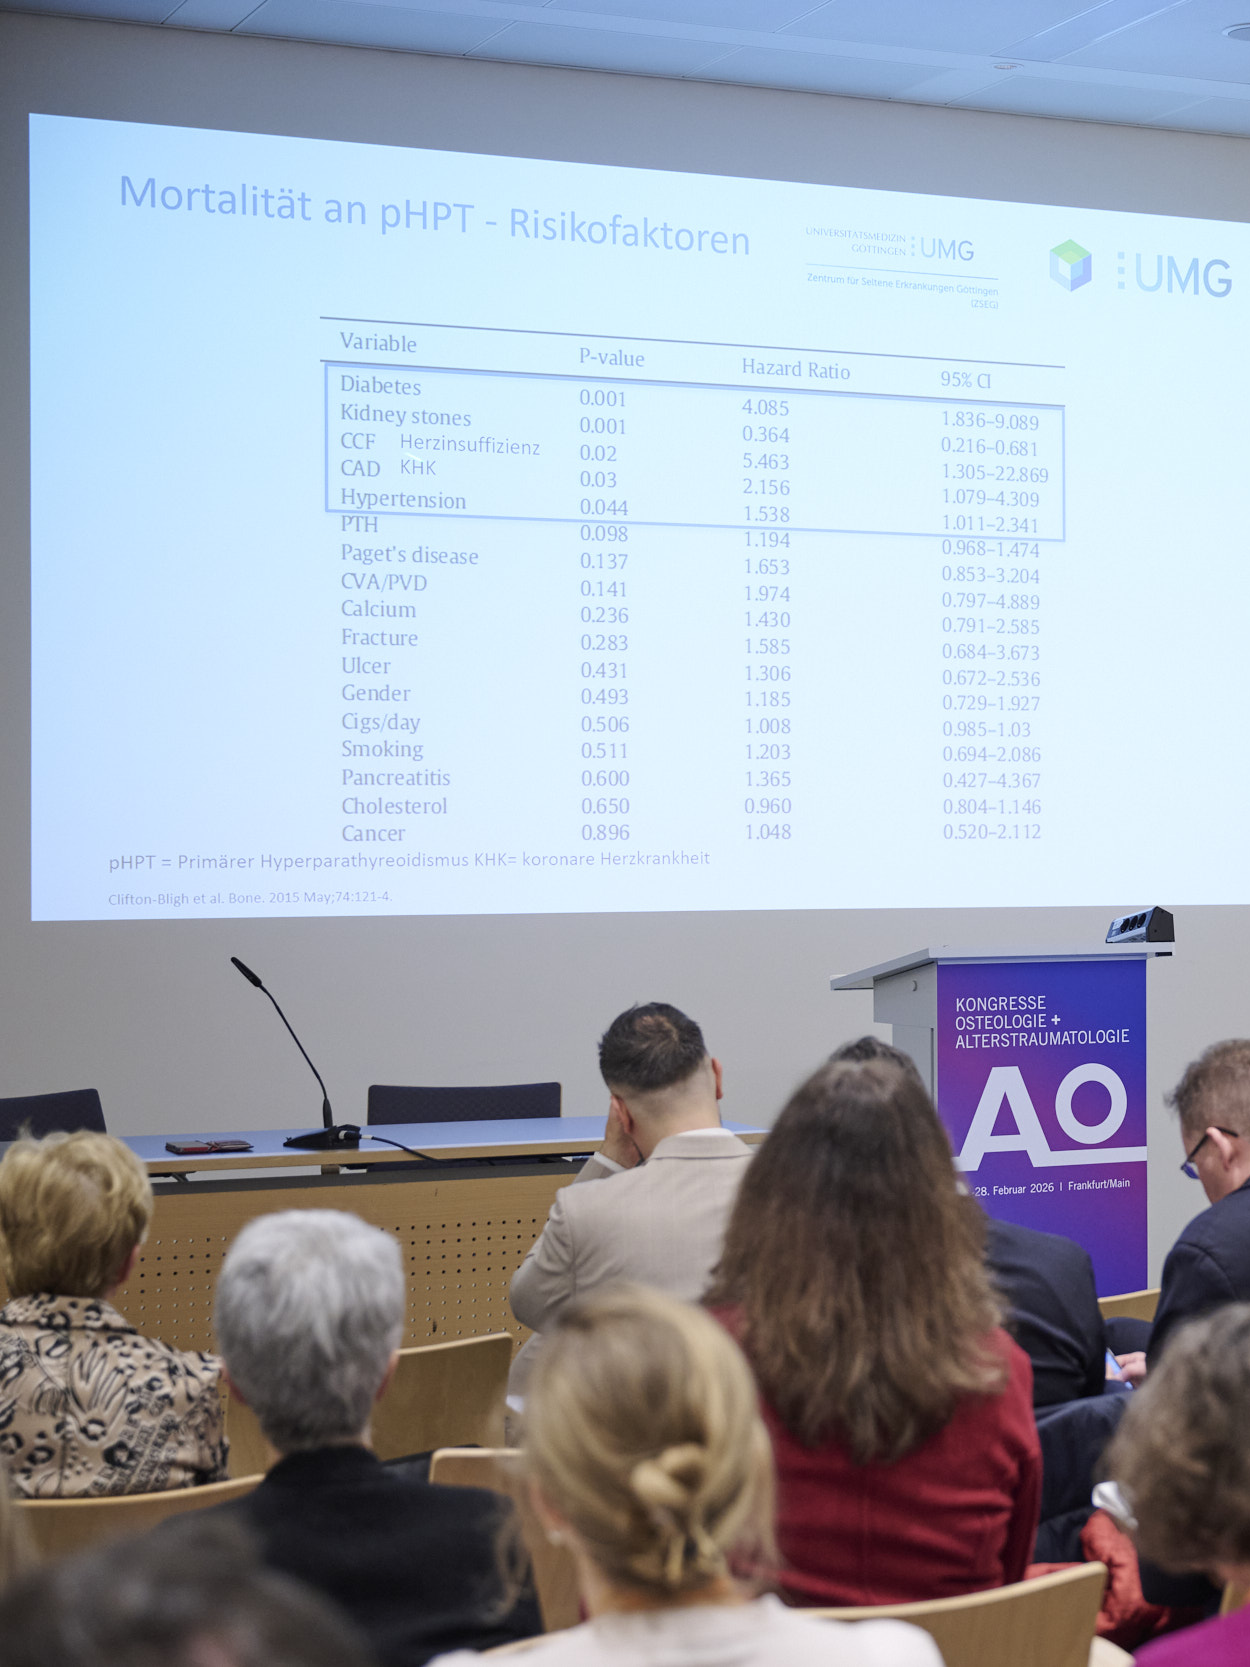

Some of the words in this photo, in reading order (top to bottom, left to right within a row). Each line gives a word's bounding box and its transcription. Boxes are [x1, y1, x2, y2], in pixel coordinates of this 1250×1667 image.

[120, 175, 312, 222] Mortalität
[324, 197, 366, 226] an
[381, 200, 474, 235] pHPT
[510, 208, 751, 256] Risikofaktoren
[921, 236, 974, 261] UMG
[808, 273, 845, 284] Zentrum
[847, 277, 859, 285] für
[861, 278, 893, 288] Seltene
[896, 280, 954, 293] Erkrankungen
[1135, 253, 1233, 298] UMG
[340, 332, 417, 353] Variable
[580, 348, 645, 368] P-value
[742, 358, 802, 377] Hazard
[808, 362, 850, 381] Ratio
[940, 371, 973, 388] 95%
[977, 373, 992, 389] CI
[340, 375, 422, 396] Diabetes
[579, 389, 626, 407] 0.001
[742, 399, 790, 417] 4.085
[340, 404, 407, 427] Kidney
[412, 408, 472, 427] stones
[579, 417, 626, 434] 0.001
[742, 427, 790, 444] 0.364
[341, 433, 376, 449] CCF
[401, 433, 541, 456] Herzinsuffizienz
[579, 444, 617, 462] 0.02
[742, 453, 790, 470] 5.463
[341, 460, 380, 477] CAD
[401, 459, 436, 475] KHK
[580, 471, 617, 488] 0.03
[742, 479, 790, 496] 2.156
[341, 488, 466, 510] Hypertension
[580, 499, 629, 516] 0.044
[744, 506, 790, 523] 1.538
[341, 515, 378, 532] PTH
[580, 525, 629, 542] 0.098
[744, 532, 791, 548] 1.194
[412, 547, 479, 565] disease
[580, 552, 629, 570] 0.137
[744, 558, 791, 575] 1.653
[341, 572, 427, 593] CVA/PVD
[580, 580, 628, 597] 0.141
[744, 585, 791, 602] 1.974
[341, 599, 416, 618] Calcium
[580, 607, 629, 624] 0.236
[744, 611, 791, 628] 1.430
[341, 628, 418, 647] Fracture
[580, 634, 629, 651] 0.283
[744, 638, 791, 655] 1.585
[341, 657, 391, 674] Ulcer
[580, 662, 628, 679] 0.431
[744, 665, 791, 682] 1.306
[341, 684, 411, 702] Gender
[581, 688, 629, 705] 0.493
[744, 691, 791, 708] 1.185
[341, 713, 421, 734] Cigs/day
[581, 716, 630, 732] 0.506
[744, 718, 791, 734] 1.008
[341, 740, 423, 761] Smoking
[581, 742, 629, 759] 0.511
[745, 744, 791, 760] 1.203
[341, 769, 451, 786] Pancreatitis
[581, 770, 630, 787] 0.600
[745, 771, 792, 788] 1.365
[342, 798, 448, 815] Cholesterol
[581, 798, 630, 814] 0.650
[744, 798, 792, 814] 0.960
[342, 825, 406, 842] Cancer
[581, 824, 630, 841] 0.896
[745, 824, 792, 840] 1.048
[109, 855, 156, 873] pHPT
[178, 855, 254, 869] Primärer
[261, 852, 469, 872] Hyperparathyreoidismus
[474, 851, 517, 868] KHK=
[522, 850, 595, 867] koronare
[600, 849, 711, 867] Herzkrankheit
[109, 893, 189, 907] Clifton-Bligh
[193, 895, 207, 905] et
[210, 893, 225, 904] al.
[229, 893, 265, 904] Bone.
[269, 893, 300, 903] 2015
[955, 995, 1047, 1012] KONGRESSE
[955, 1014, 1047, 1031] OSTEOLOGIE
[955, 1029, 1130, 1049] ALTERSTRAUMATOLOGIE
[955, 1063, 1128, 1172] AO
[993, 1185, 1026, 1195] Februar
[1030, 1183, 1054, 1193] 2026
[1068, 1178, 1130, 1191] Frankfurt/Main
